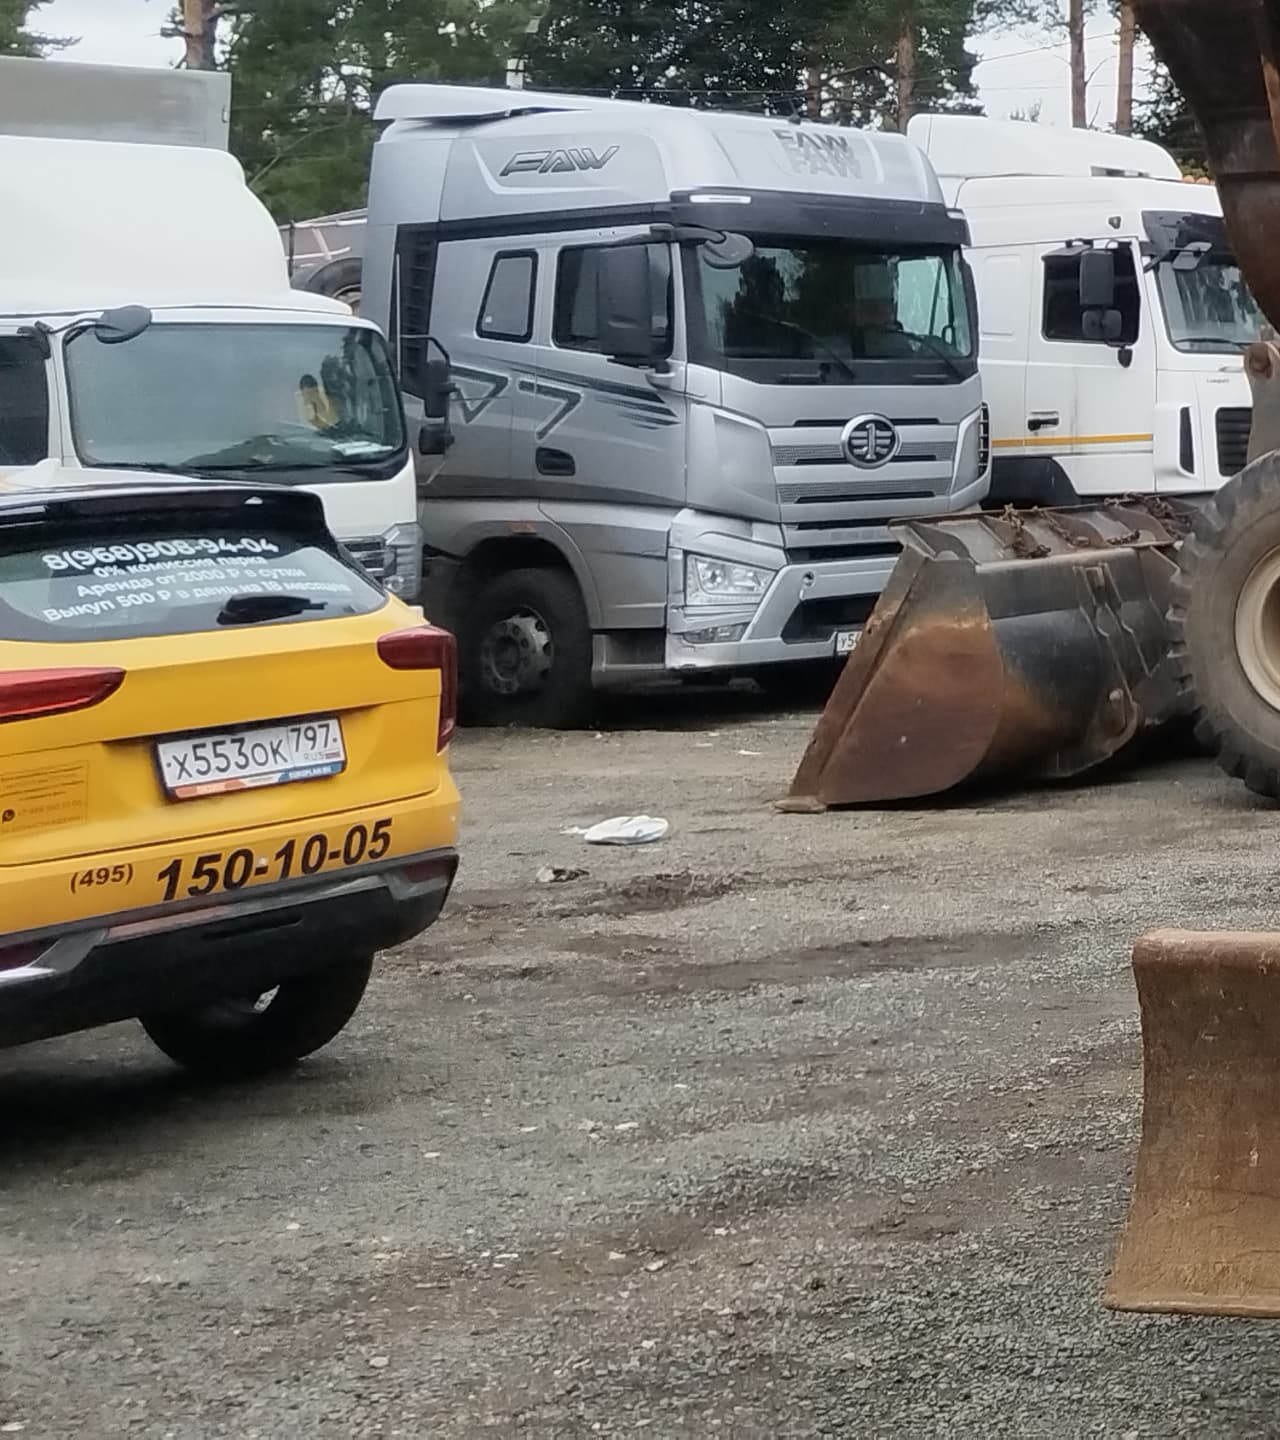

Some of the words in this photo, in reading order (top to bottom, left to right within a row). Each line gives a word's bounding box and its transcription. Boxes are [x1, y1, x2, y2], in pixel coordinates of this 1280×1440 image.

[499, 145, 620, 176] FAW
[41, 538, 279, 571] 8(968)908-94-04
[76, 577, 155, 598] Аренда
[155, 574, 177, 585] от
[42, 598, 116, 622] Выкуп
[115, 591, 156, 608] 500
[171, 736, 288, 781] Х553ОК
[289, 723, 331, 753] 797
[69, 862, 134, 894] (495)
[157, 817, 393, 902] 150-10-05
